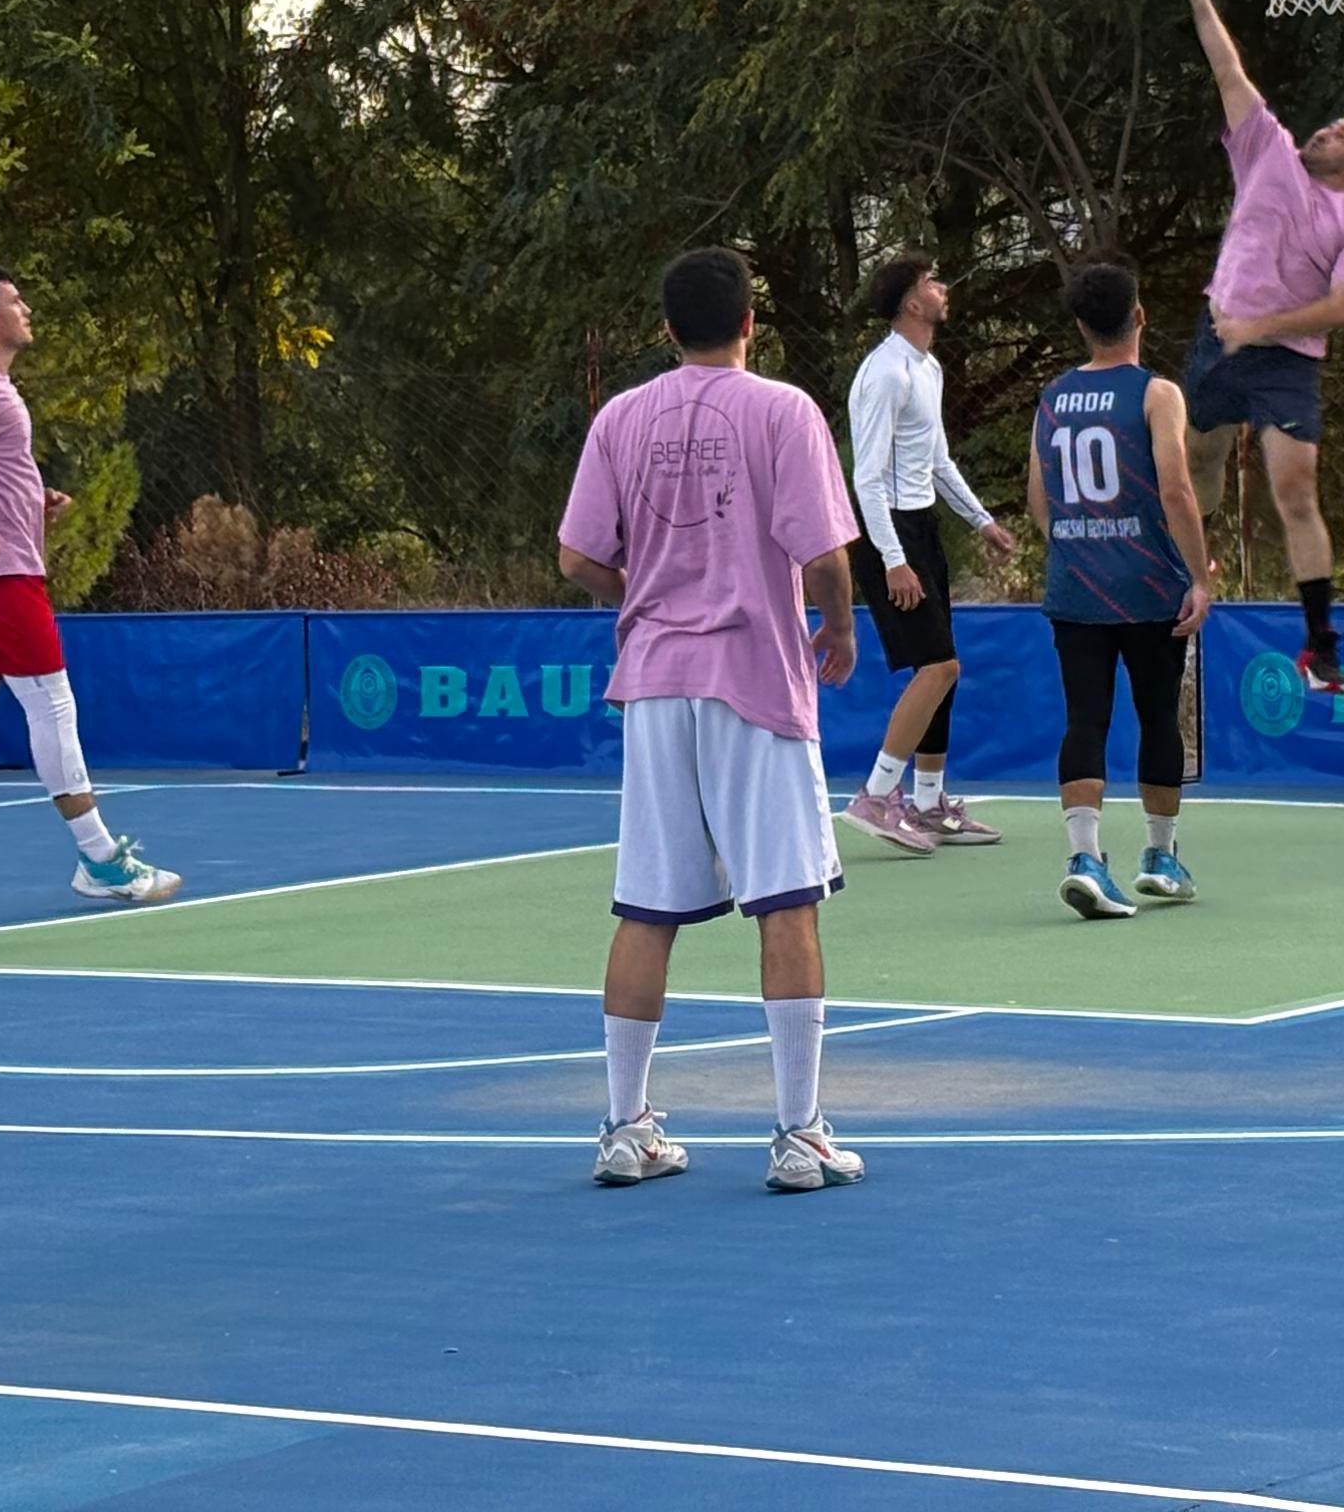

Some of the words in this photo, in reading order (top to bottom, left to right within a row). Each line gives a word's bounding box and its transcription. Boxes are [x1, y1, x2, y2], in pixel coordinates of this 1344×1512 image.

[1054, 391, 1115, 414] ARDA
[1050, 426, 1120, 504] 10
[418, 664, 623, 717] BAU
